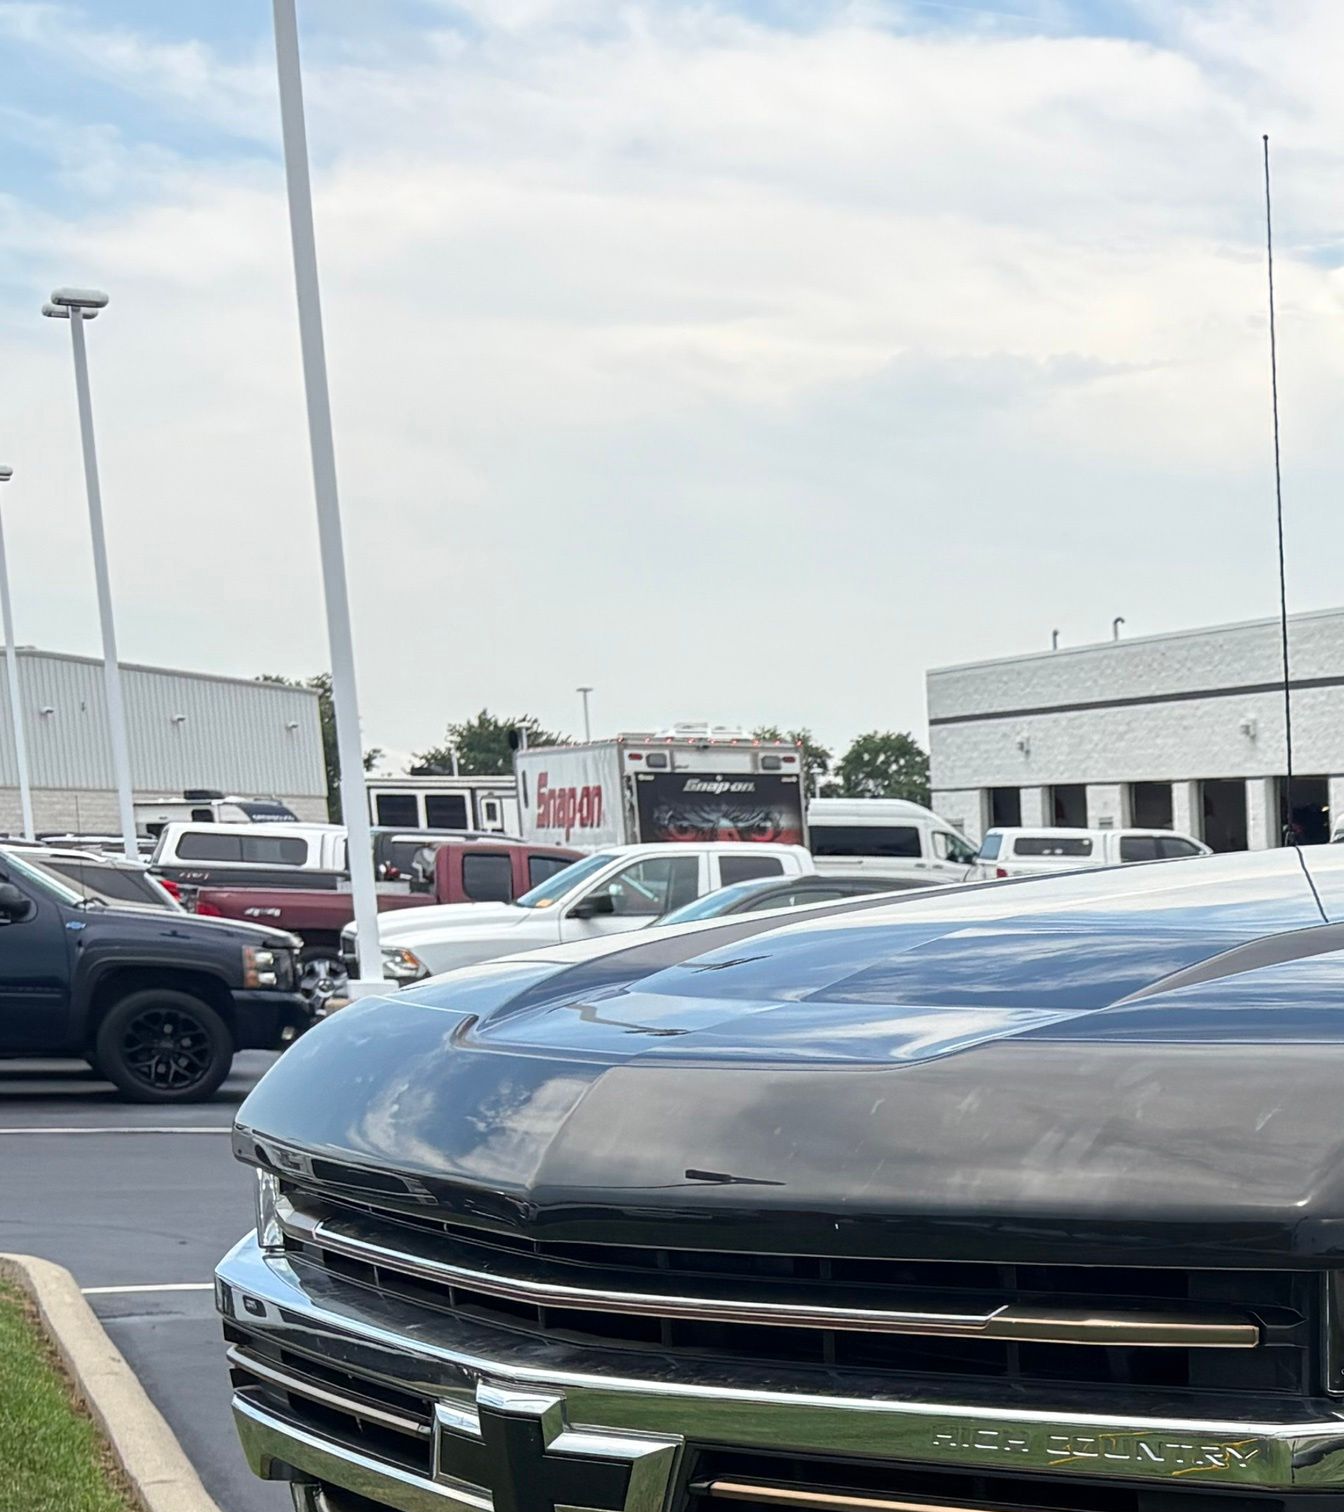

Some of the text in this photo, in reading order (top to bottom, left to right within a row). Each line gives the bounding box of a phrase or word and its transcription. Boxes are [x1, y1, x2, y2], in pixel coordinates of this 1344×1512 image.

[535, 771, 605, 843] Snap-on
[931, 1428, 1261, 1468] HIGH COUNTRY
